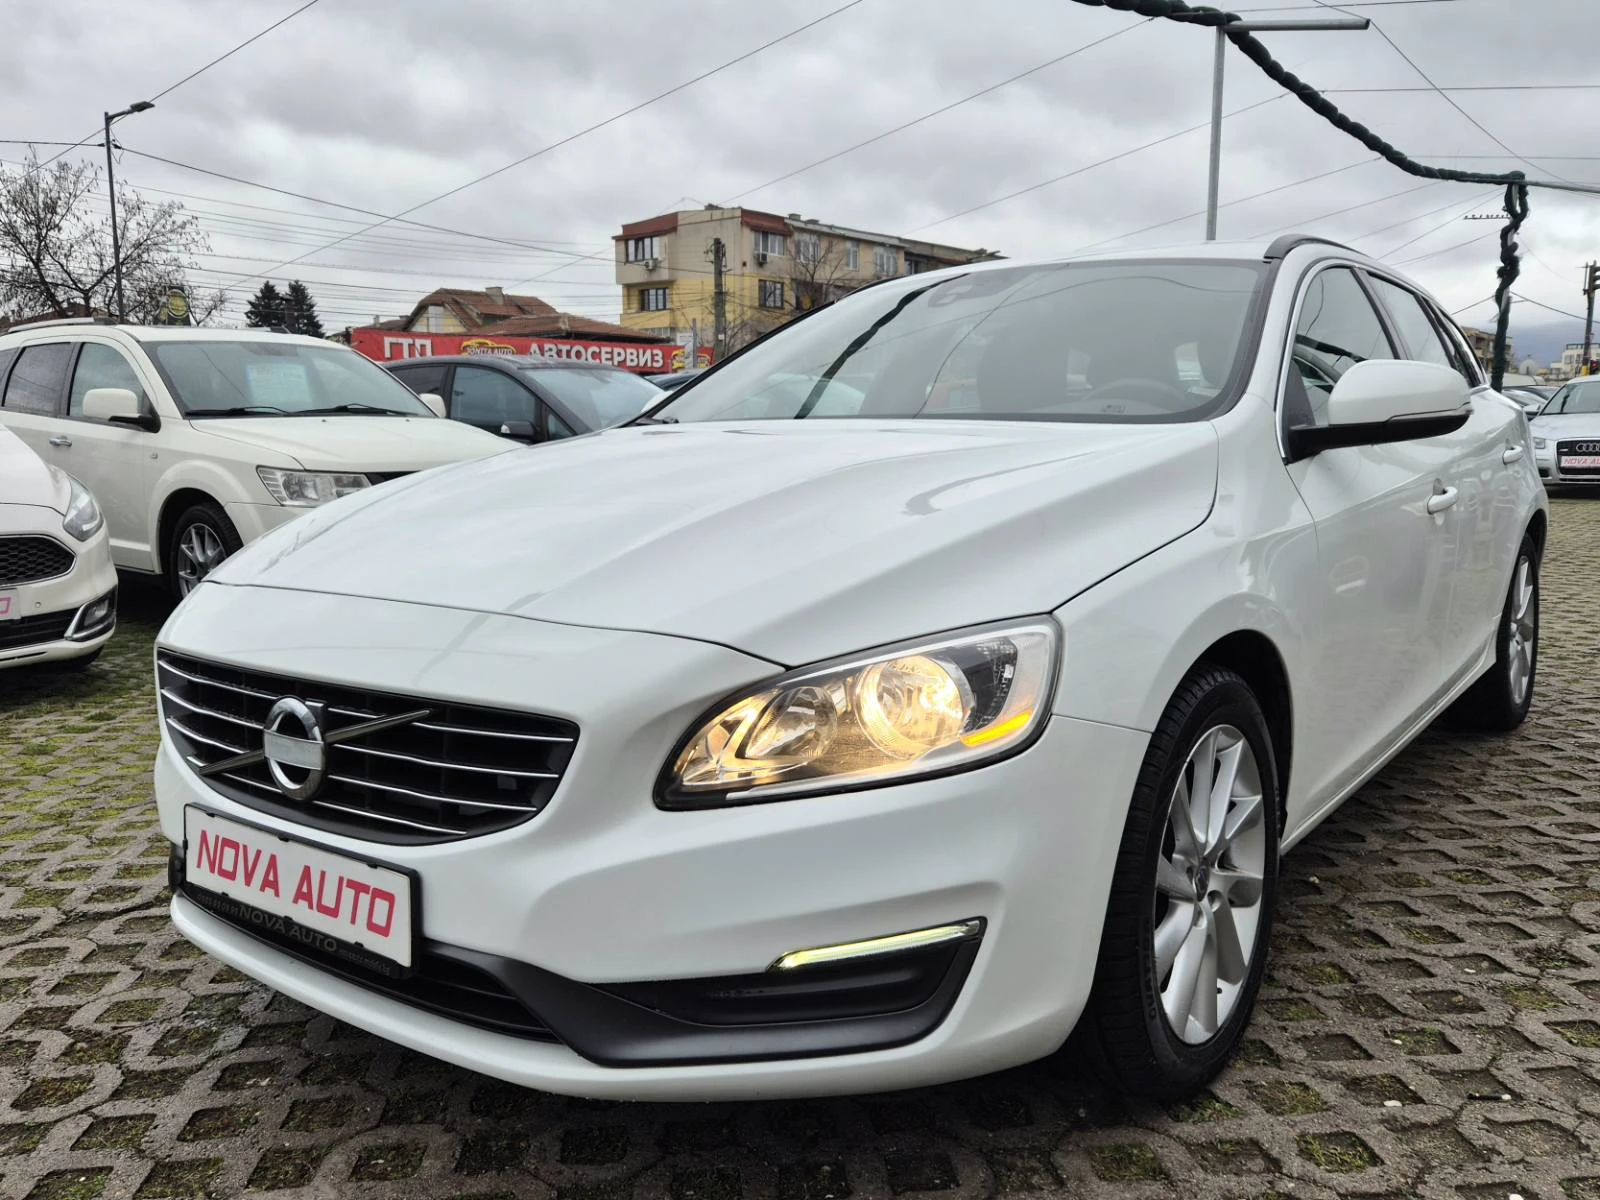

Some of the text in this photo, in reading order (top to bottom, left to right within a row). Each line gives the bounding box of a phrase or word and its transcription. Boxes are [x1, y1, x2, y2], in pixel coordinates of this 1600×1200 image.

[528, 343, 664, 368] АВТОСЕРВИЗ
[1564, 457, 1588, 465] NOVA
[196, 829, 396, 938] NOVA AUTO
[239, 904, 286, 935] NOVA
[289, 927, 337, 952] AUTO
